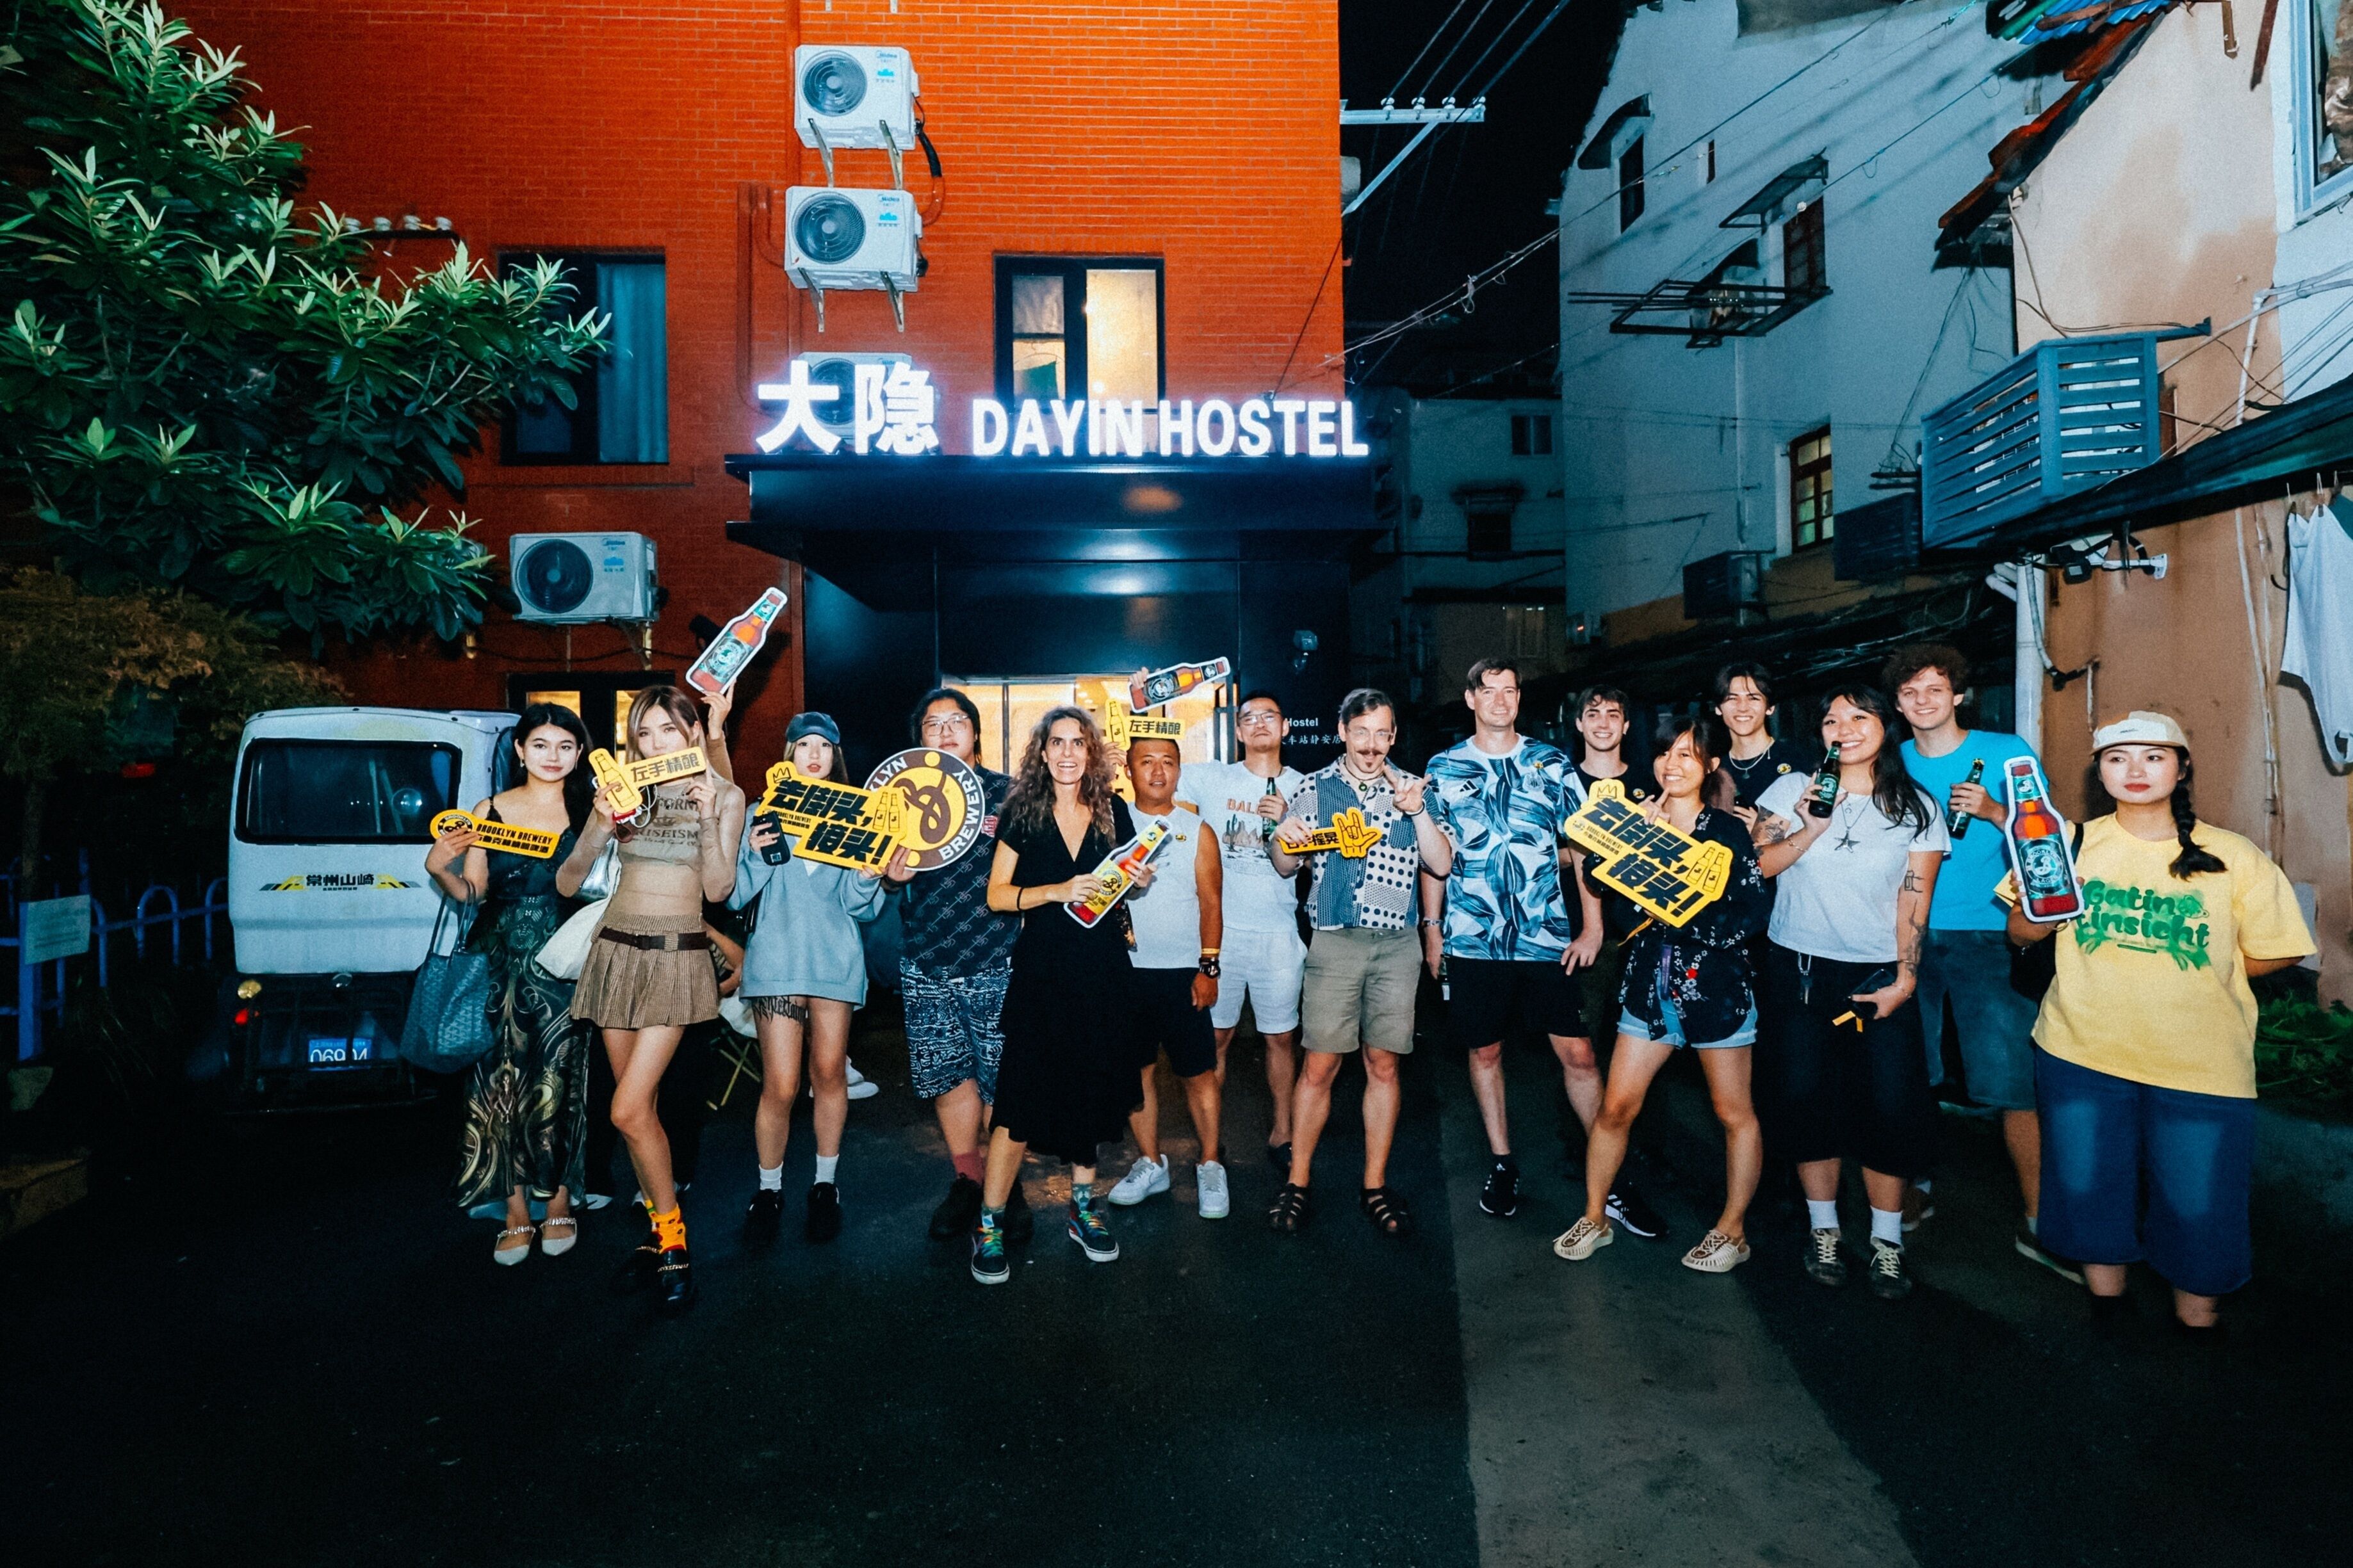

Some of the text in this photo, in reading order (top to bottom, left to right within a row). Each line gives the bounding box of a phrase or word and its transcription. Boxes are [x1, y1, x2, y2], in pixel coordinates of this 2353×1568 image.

[756, 360, 940, 454] 大隐
[972, 398, 1369, 457] DAYIN HOSTEL
[1129, 720, 1181, 735] 左手精酿
[631, 752, 701, 782] 左手精酿
[938, 768, 980, 861] BREWERY
[476, 823, 553, 845] BROOKLYN BREWERY
[306, 873, 375, 886] 常州山崎
